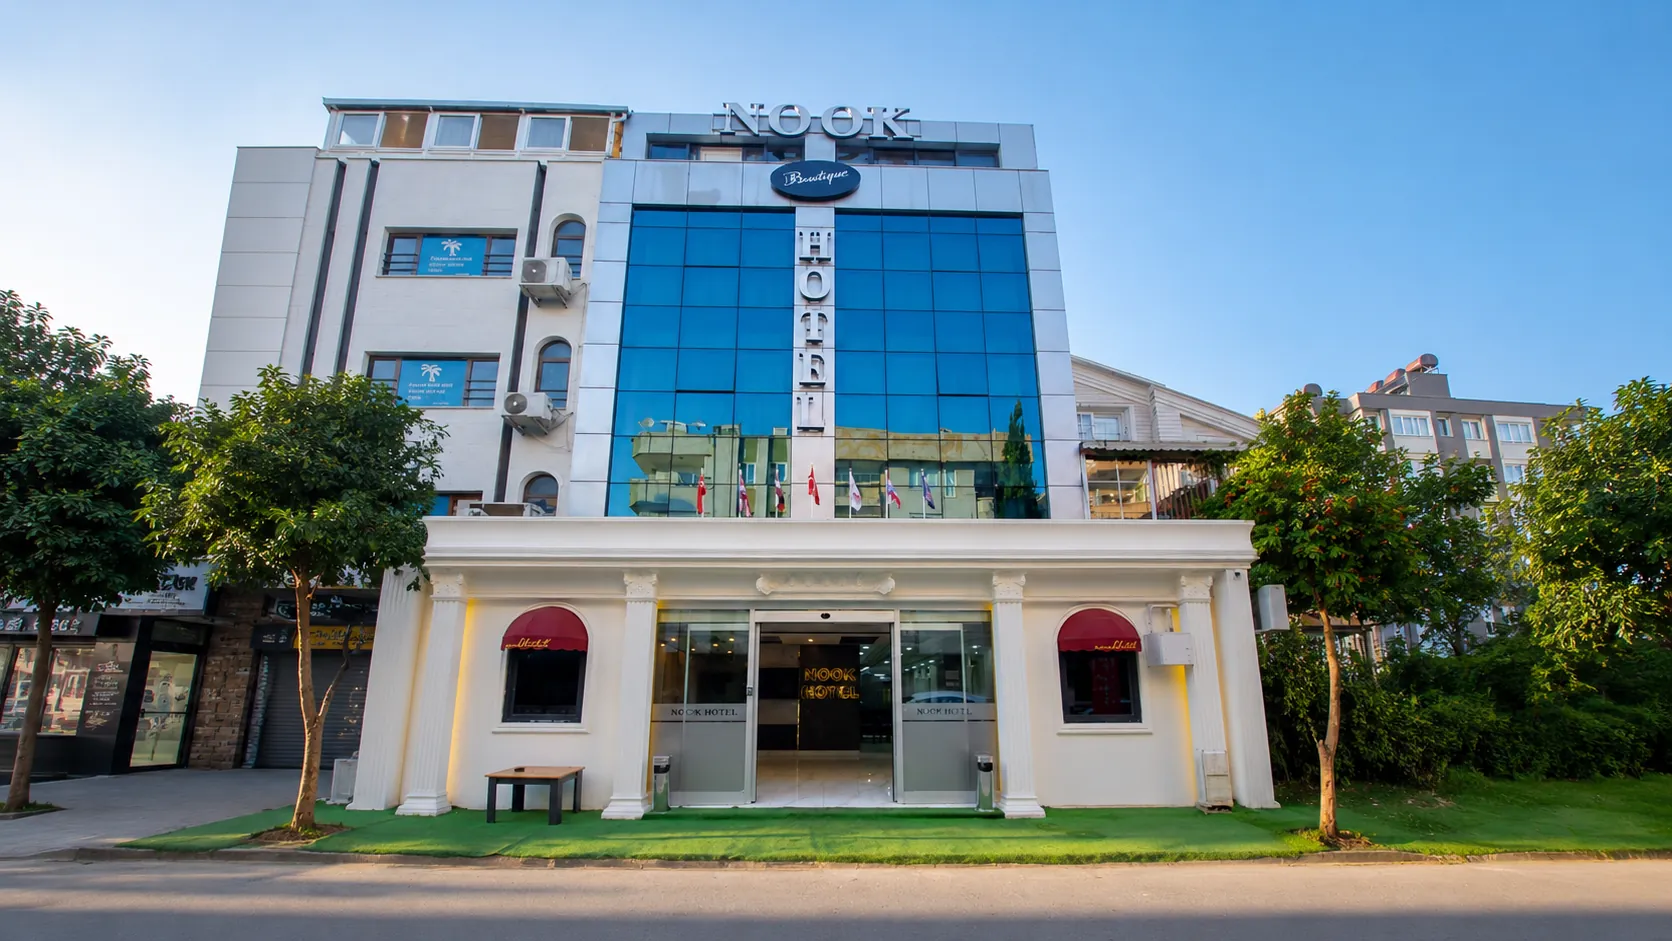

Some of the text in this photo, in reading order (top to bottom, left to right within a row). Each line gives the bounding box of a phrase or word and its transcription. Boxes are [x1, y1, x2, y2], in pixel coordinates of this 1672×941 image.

[720, 102, 914, 141] NOOK
[797, 231, 832, 433] HOTEL
[804, 667, 857, 681] NOOK
[801, 685, 860, 700] HOTEL
[670, 708, 738, 716] NOOK HOTEL
[944, 707, 973, 716] HOTL
